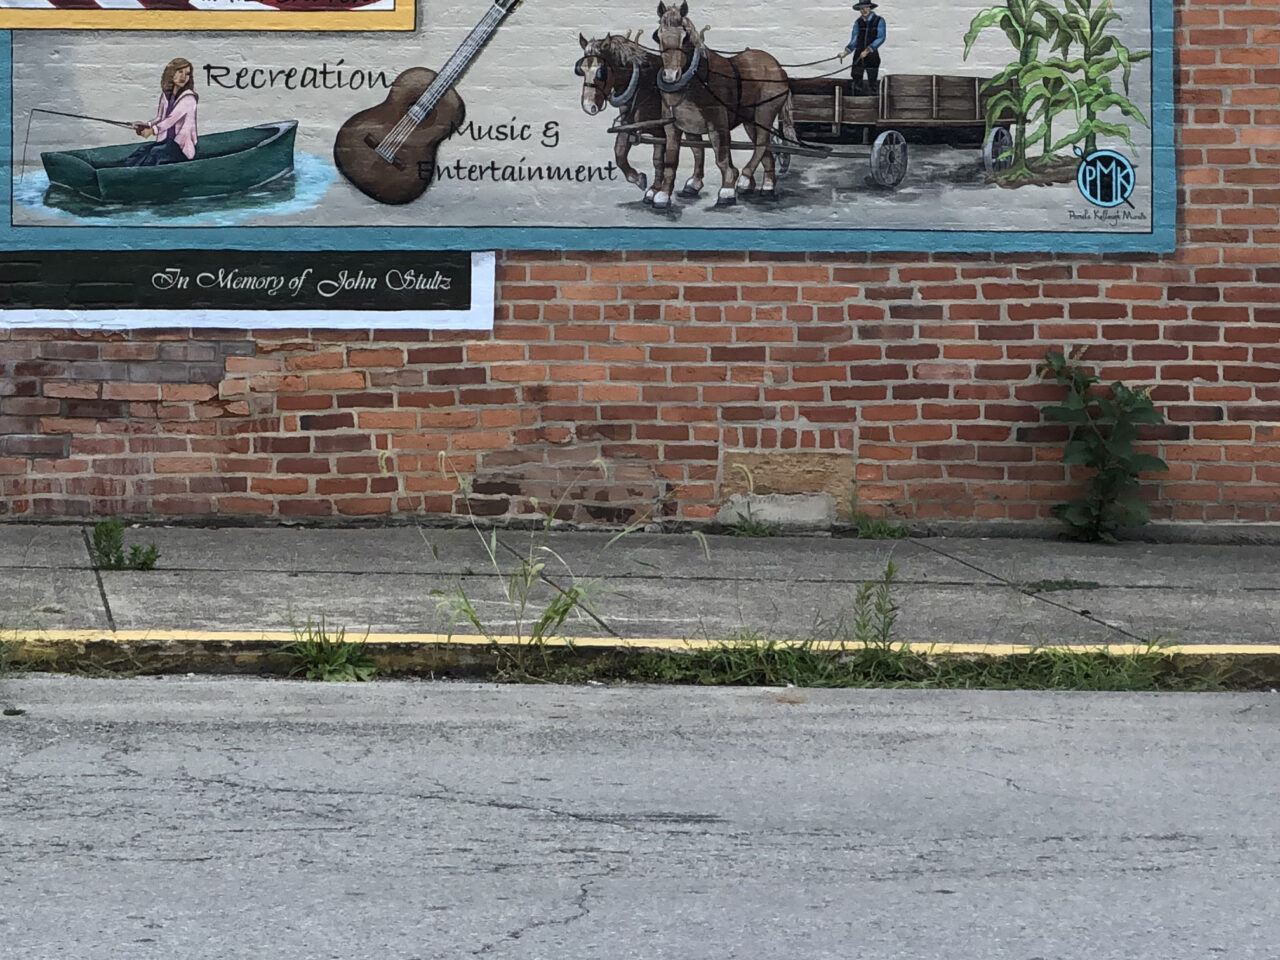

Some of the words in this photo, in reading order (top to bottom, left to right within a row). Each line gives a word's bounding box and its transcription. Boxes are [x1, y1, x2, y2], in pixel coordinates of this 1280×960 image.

[203, 58, 394, 90] Recreation
[449, 116, 532, 141] Music
[541, 120, 560, 147] &
[417, 157, 618, 182] Entertainment
[152, 268, 189, 290] In
[196, 268, 284, 296] Memory
[288, 268, 313, 296] of
[317, 269, 377, 297] John
[385, 269, 451, 291] Stultz
